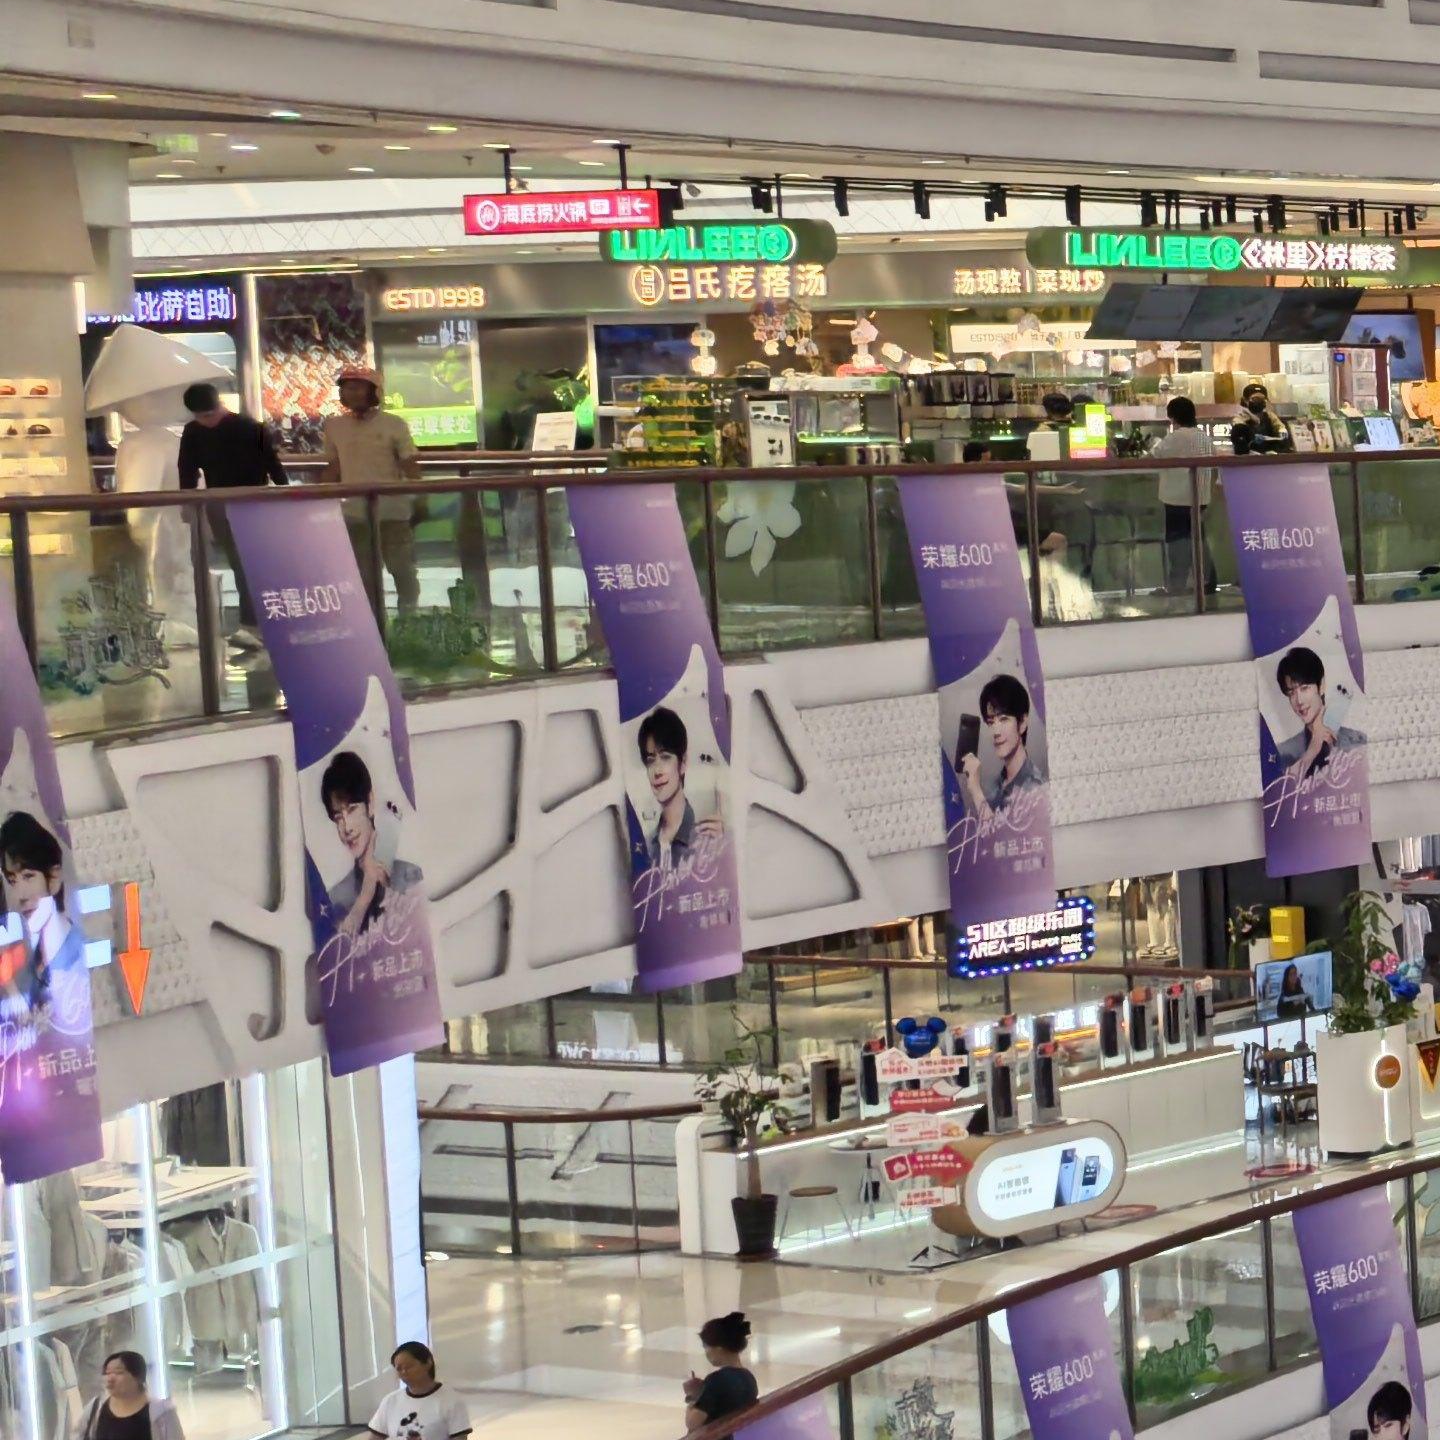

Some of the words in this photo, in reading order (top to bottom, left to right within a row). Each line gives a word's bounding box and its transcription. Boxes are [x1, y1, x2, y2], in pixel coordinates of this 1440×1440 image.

[438, 286, 486, 309] 1998
[667, 263, 828, 301] 吕氏疙瘩汤
[1241, 525, 1315, 552] 荣耀600
[921, 542, 993, 570] 荣耀600
[594, 561, 670, 592] 荣耀600
[262, 582, 342, 621] 荣耀600
[38, 1048, 98, 1082] 新品上
